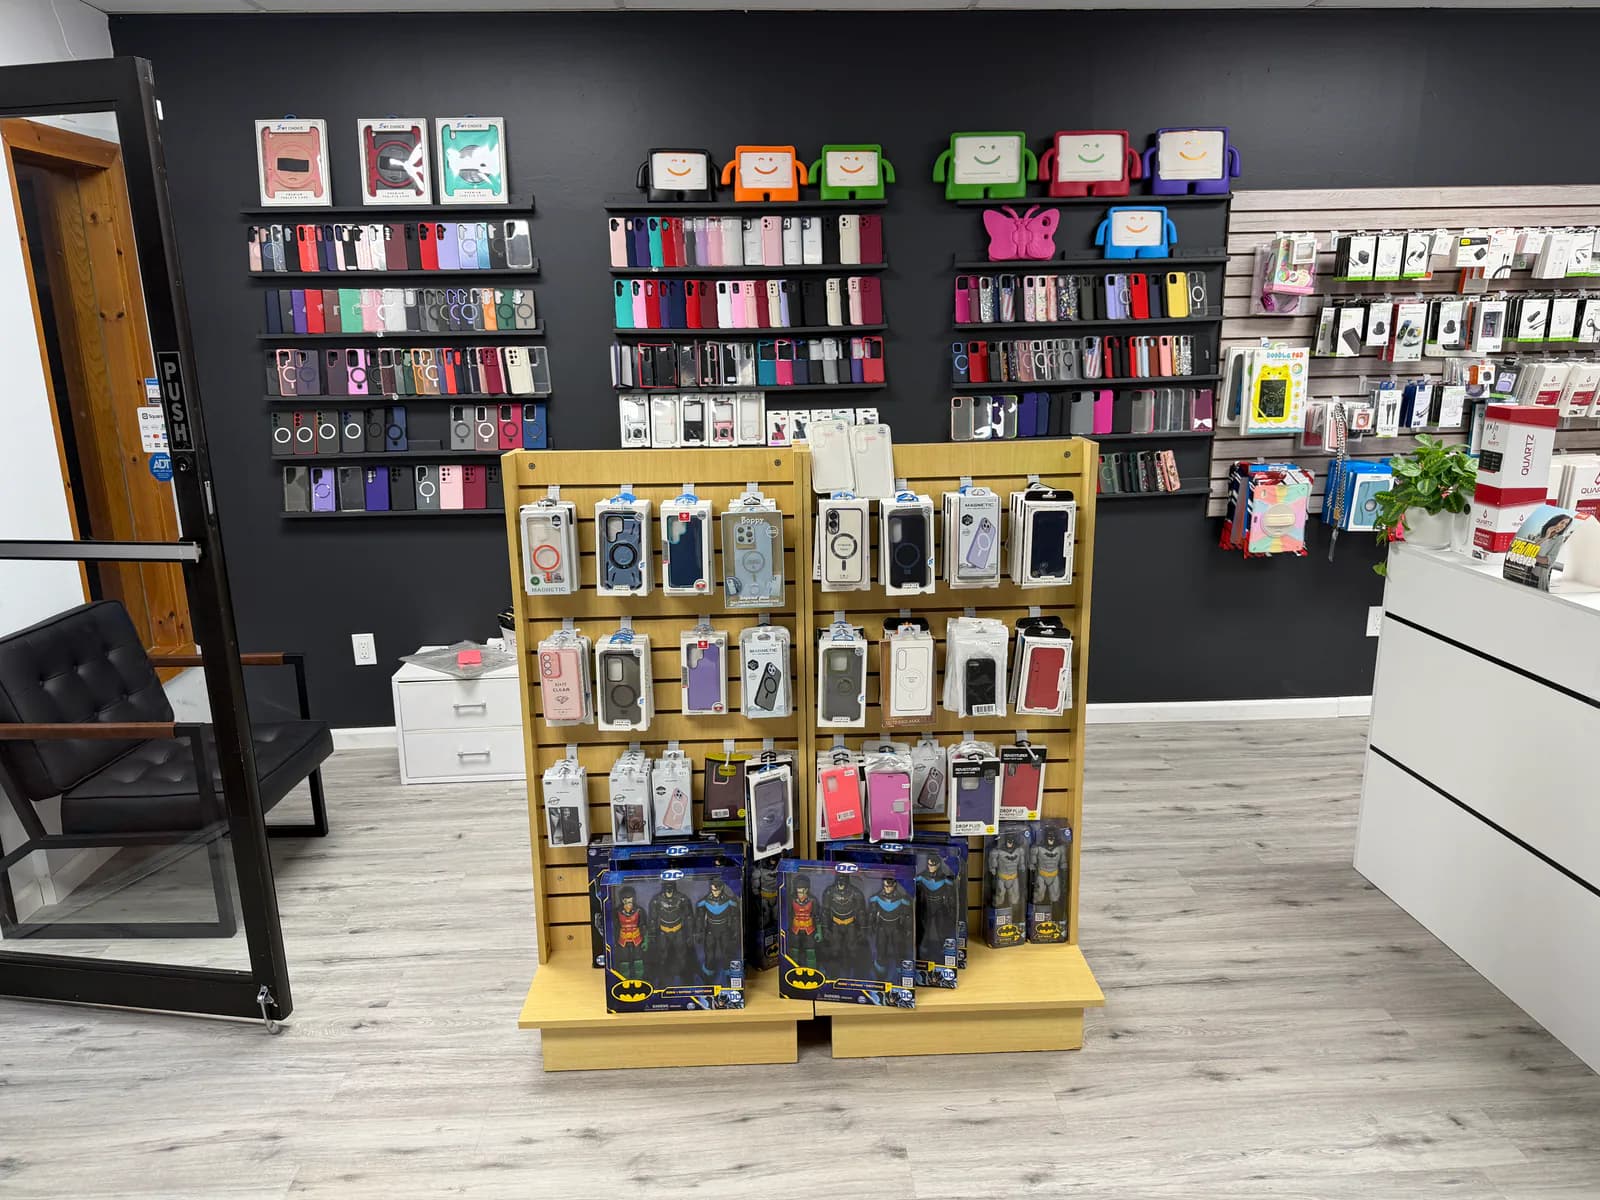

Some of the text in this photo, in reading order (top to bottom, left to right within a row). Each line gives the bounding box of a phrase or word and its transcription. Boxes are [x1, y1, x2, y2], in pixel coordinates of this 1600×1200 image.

[163, 361, 187, 442] PUSH
[153, 459, 171, 469] ADT
[1521, 434, 1534, 476] QUARTZ
[943, 971, 955, 979] DC
